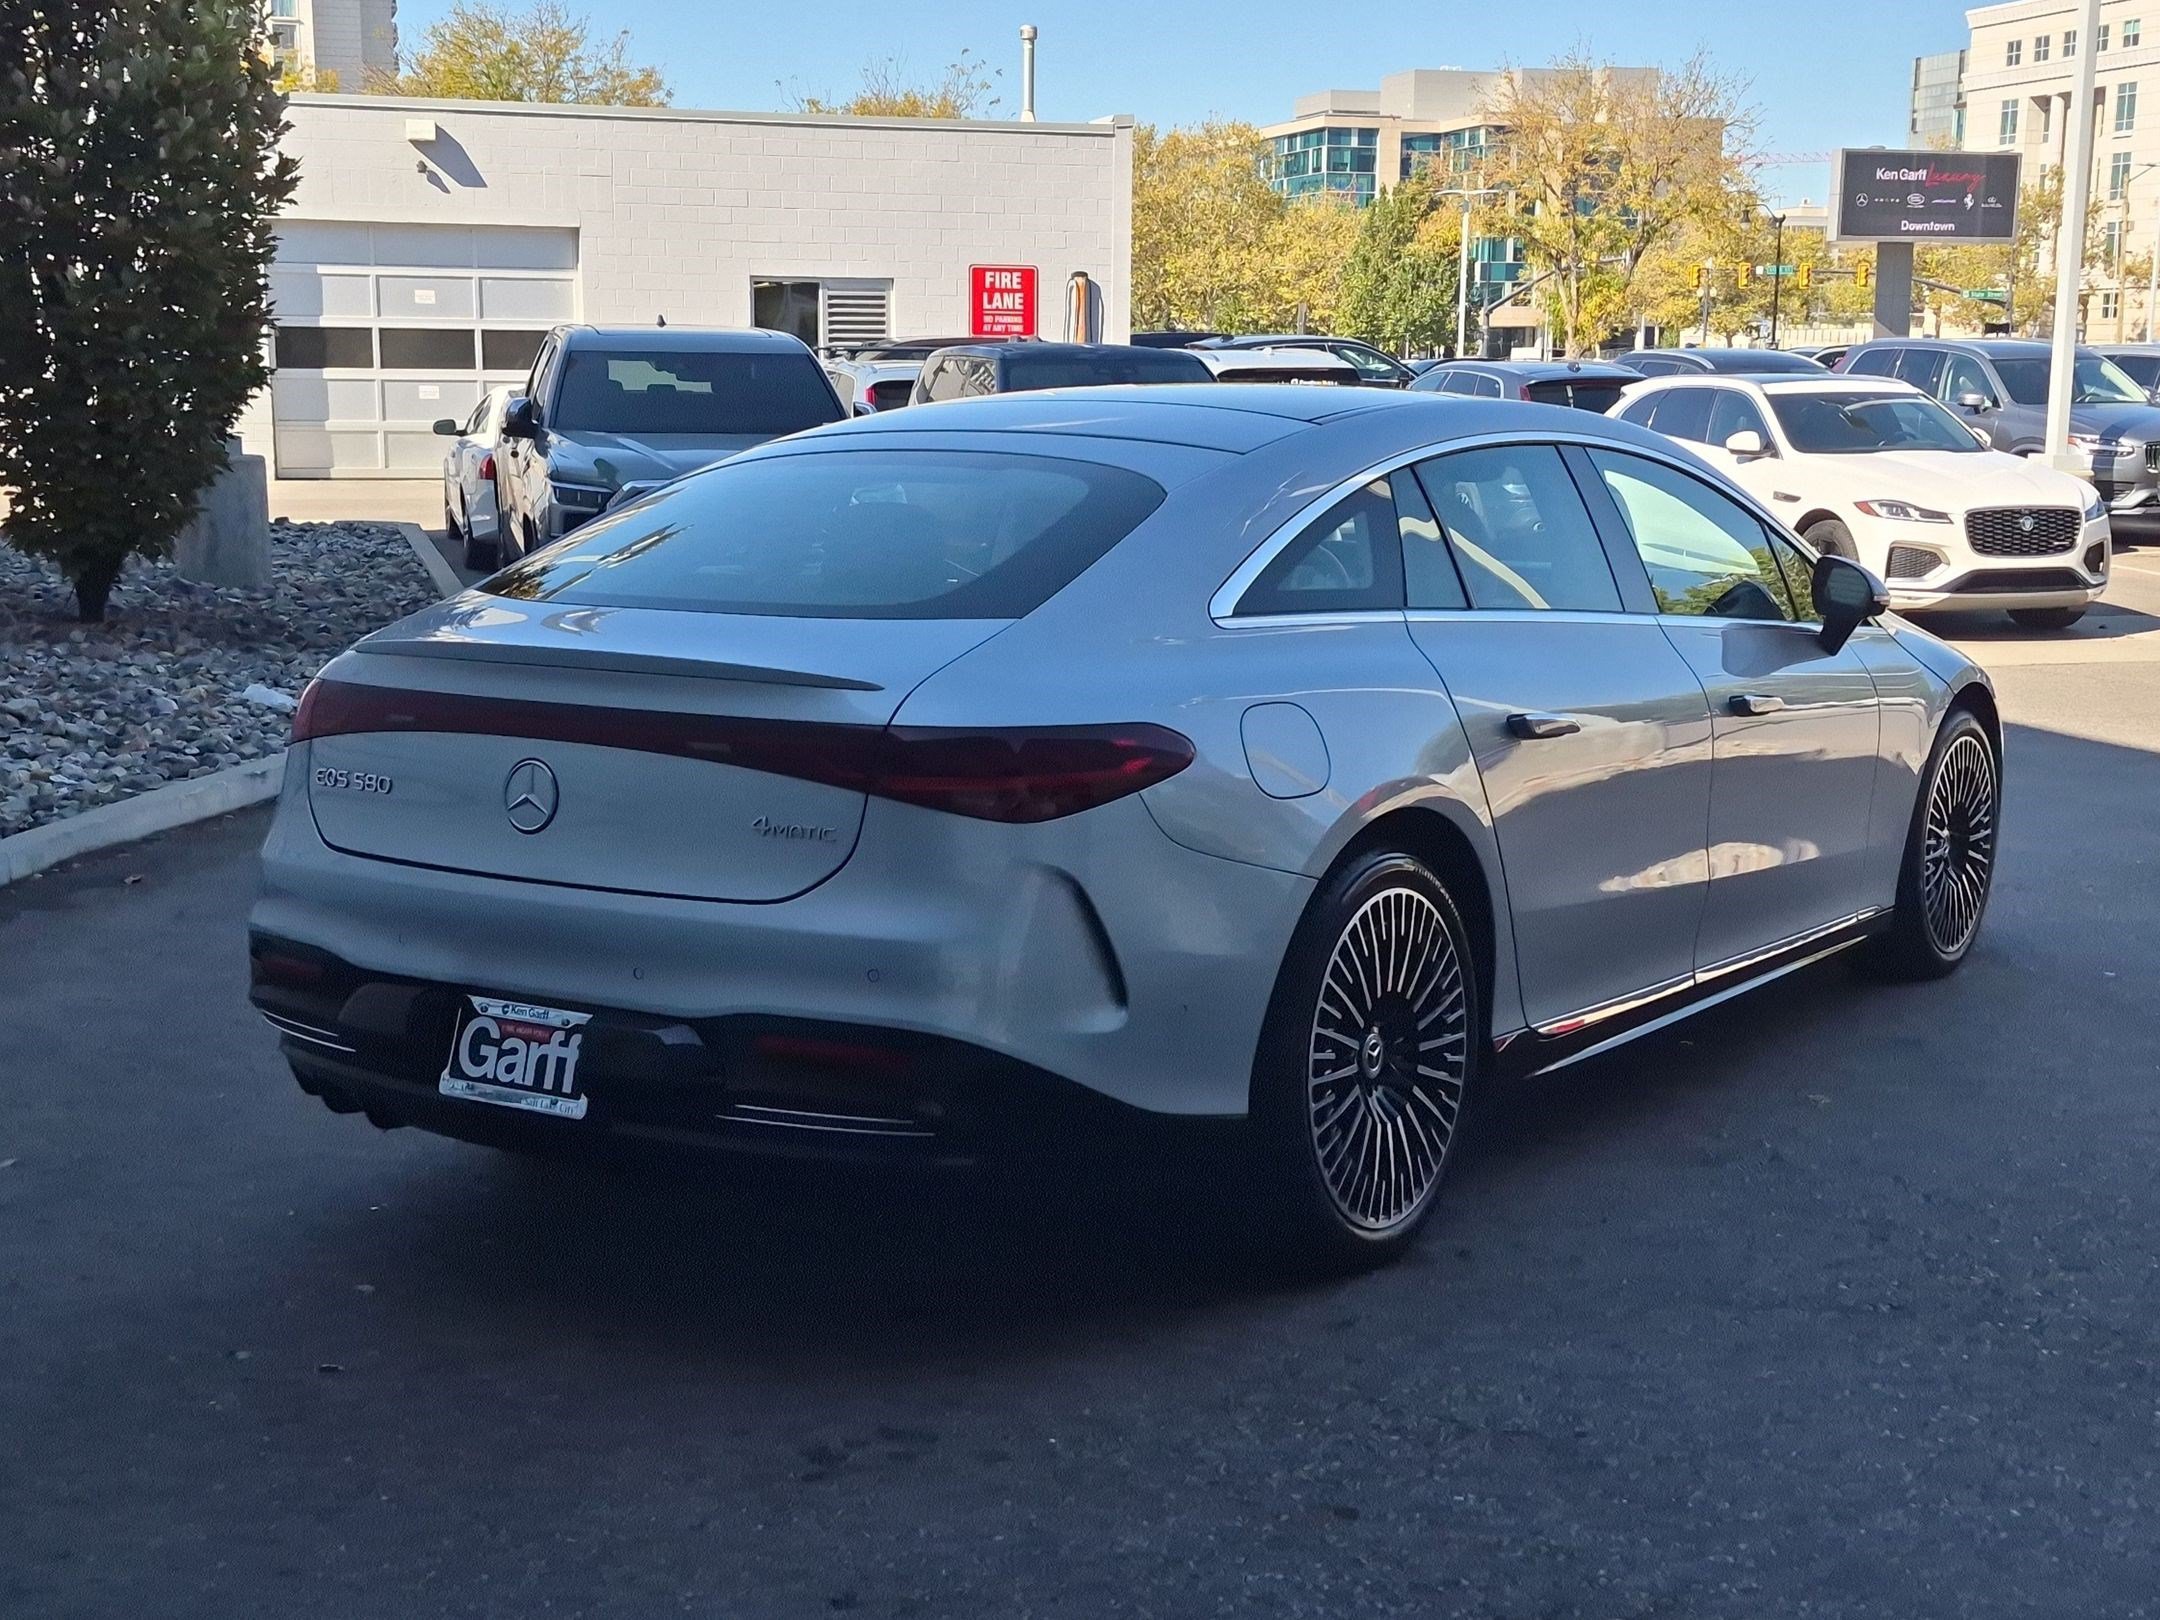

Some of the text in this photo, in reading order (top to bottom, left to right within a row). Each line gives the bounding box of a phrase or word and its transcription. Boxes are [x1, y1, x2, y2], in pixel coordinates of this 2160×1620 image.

[1876, 168, 1898, 180] Ken
[1900, 168, 1927, 180] Garff
[1901, 220, 1955, 232] Downtown
[985, 271, 1022, 289] FIRE
[983, 292, 1024, 310] LANE
[992, 324, 1006, 333] ANY
[315, 767, 393, 795] EQS 580
[752, 815, 837, 842] 4MATIC
[511, 1004, 550, 1020] Ken Garff
[459, 1016, 582, 1094] Garff
